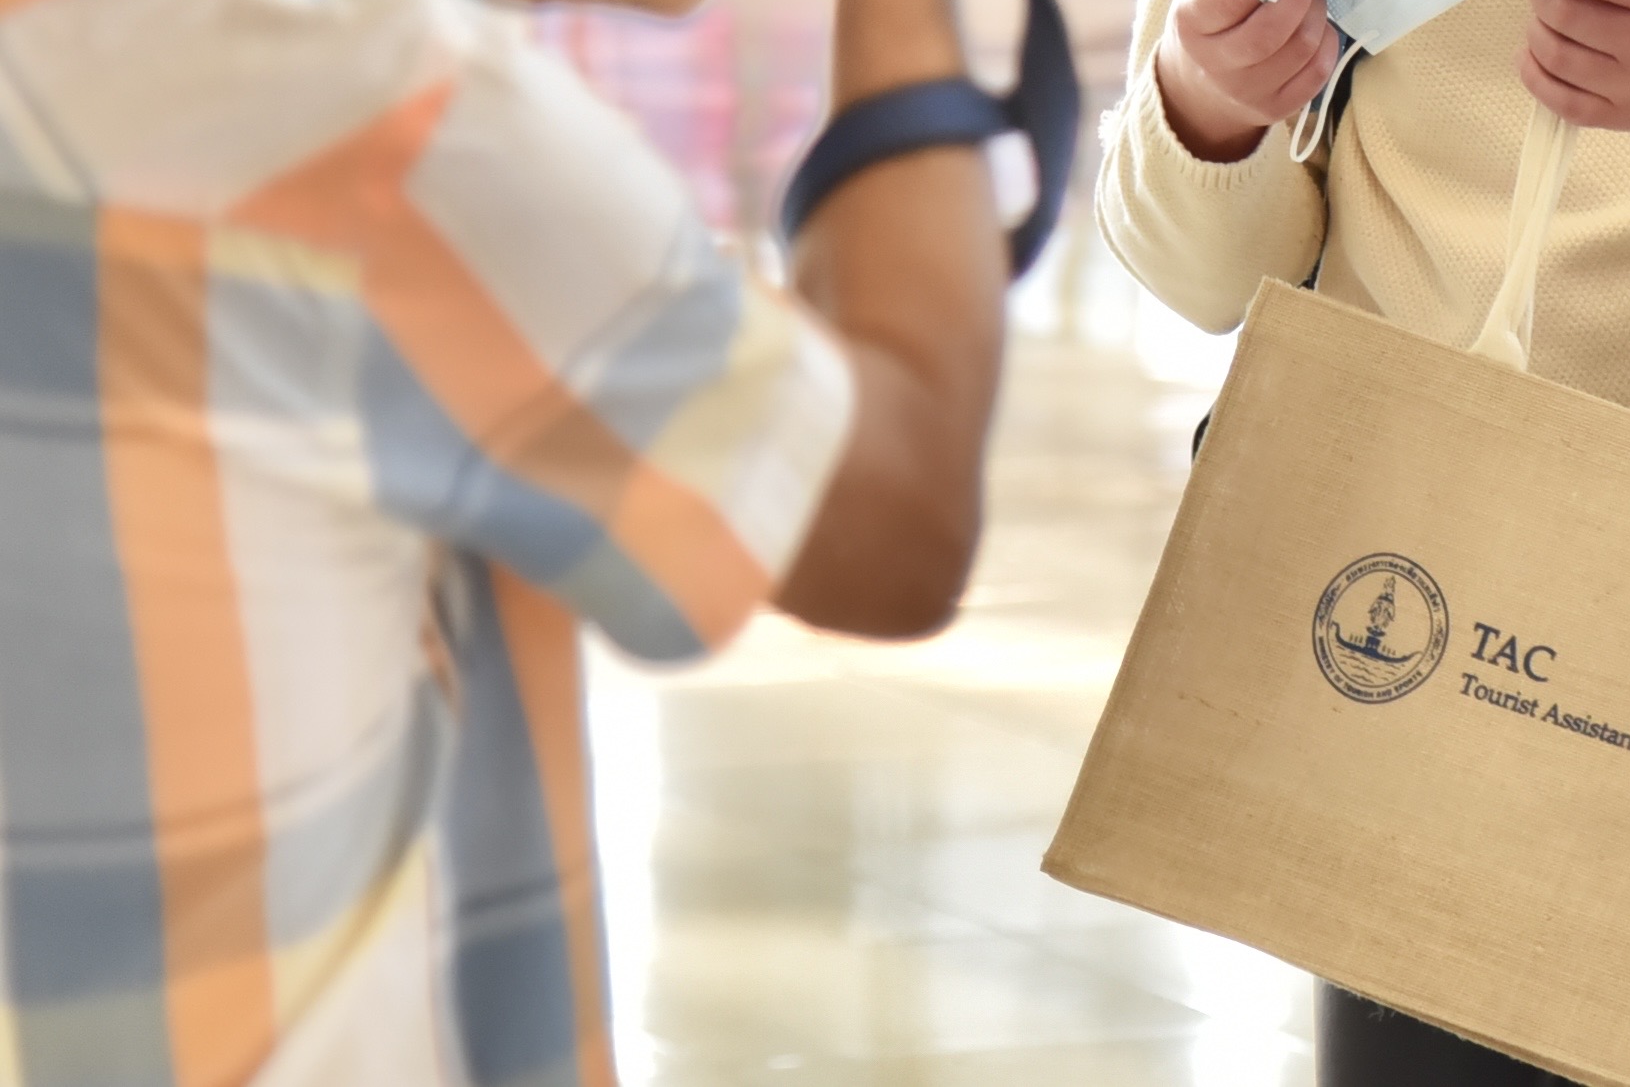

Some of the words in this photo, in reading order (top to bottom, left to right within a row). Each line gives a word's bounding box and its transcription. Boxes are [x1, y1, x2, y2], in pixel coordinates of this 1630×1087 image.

[1470, 621, 1557, 683] TAC
[1375, 689, 1393, 699] AND
[1393, 670, 1423, 694] SPORTS
[1459, 672, 1540, 718] Tourist
